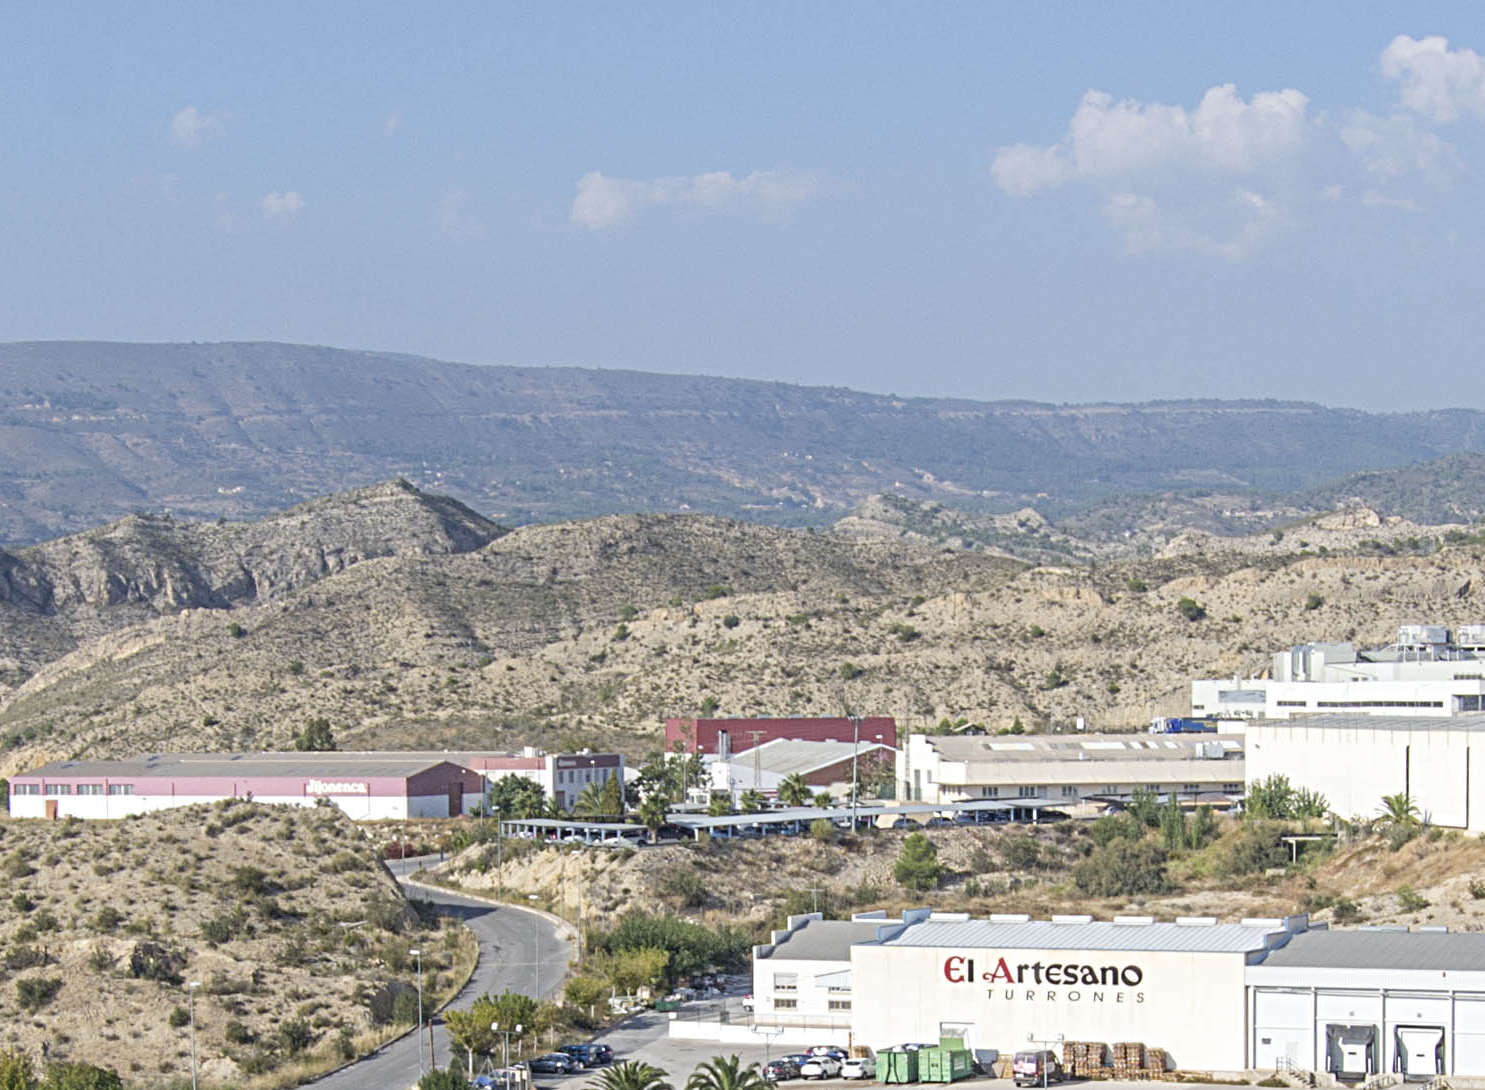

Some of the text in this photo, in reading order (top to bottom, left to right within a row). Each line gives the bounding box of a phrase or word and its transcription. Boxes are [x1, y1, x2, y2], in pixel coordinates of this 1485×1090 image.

[944, 956, 1143, 987] El Artesano
[987, 989, 1145, 1003] TURRONES
